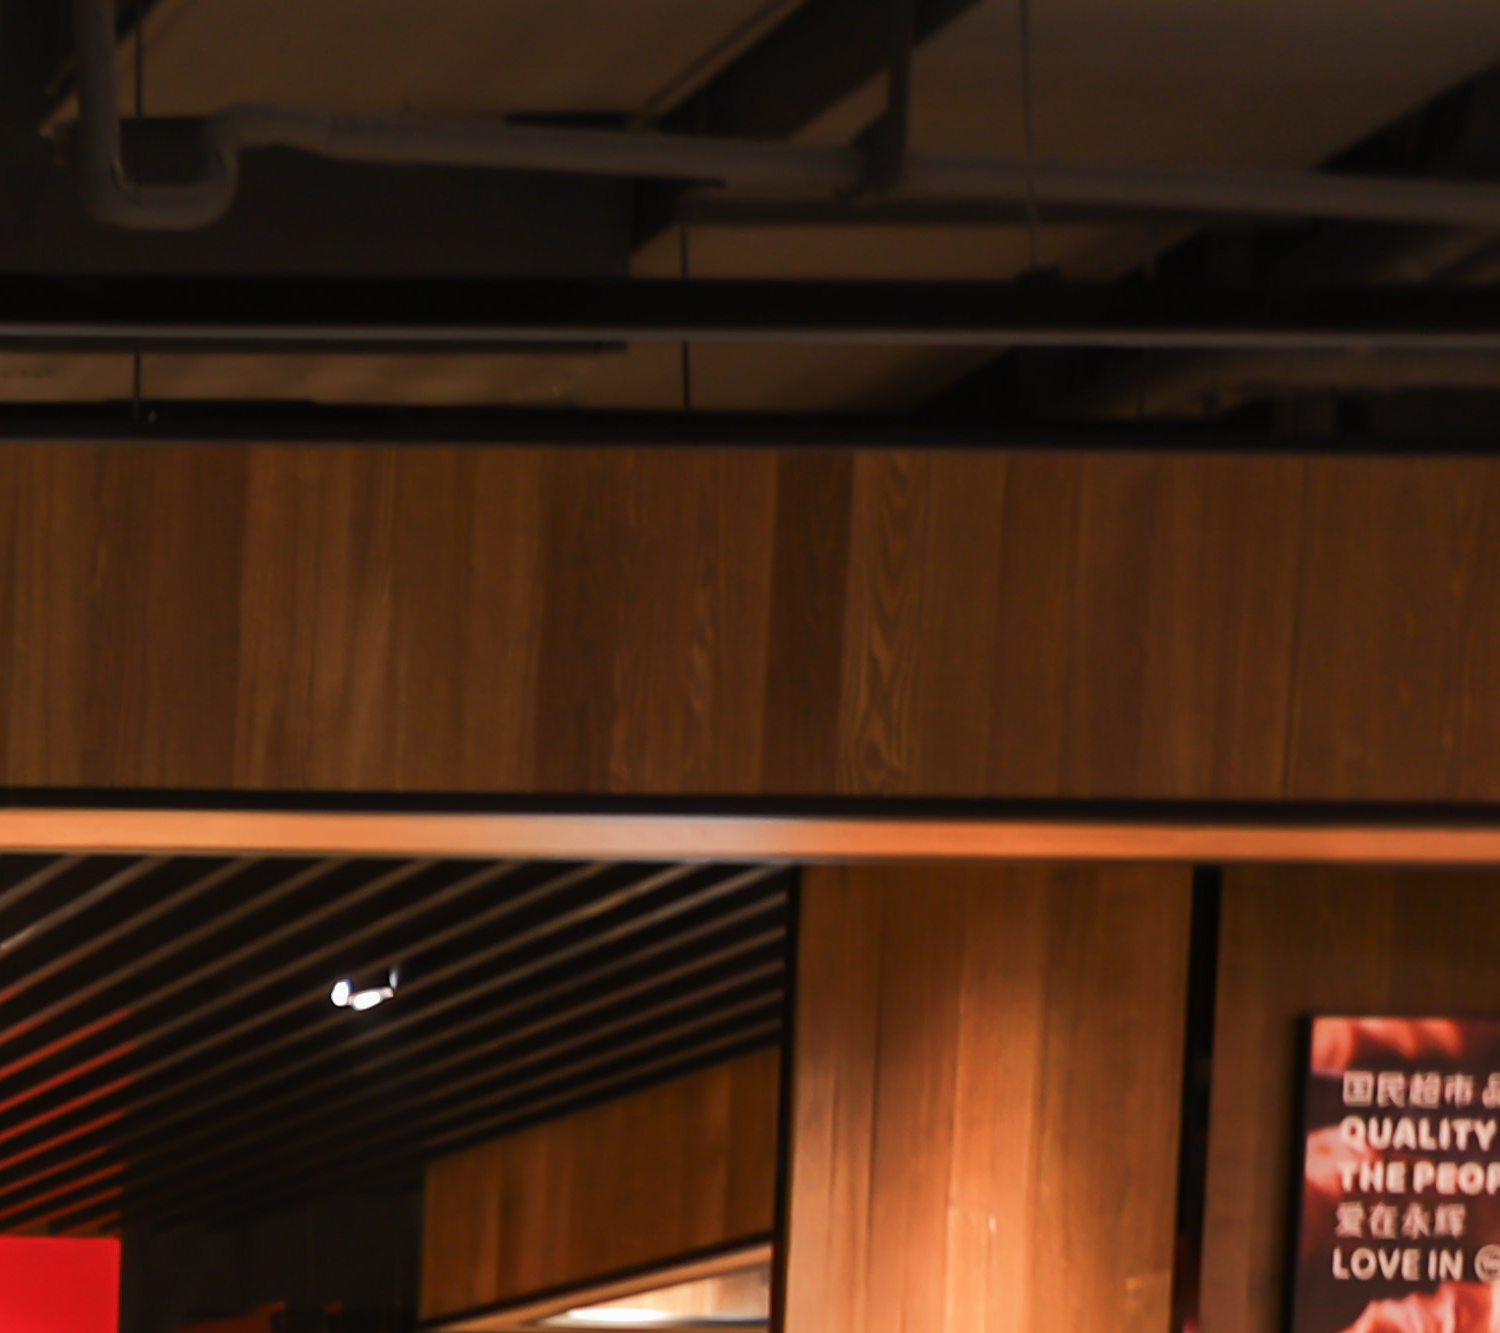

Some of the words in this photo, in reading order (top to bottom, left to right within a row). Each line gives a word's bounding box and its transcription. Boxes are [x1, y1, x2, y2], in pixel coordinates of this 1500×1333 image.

[1339, 1115, 1497, 1152] QUALITY
[1338, 1160, 1406, 1194] THE
[1332, 1246, 1420, 1281] LOVE
[1428, 1247, 1464, 1281] IN
